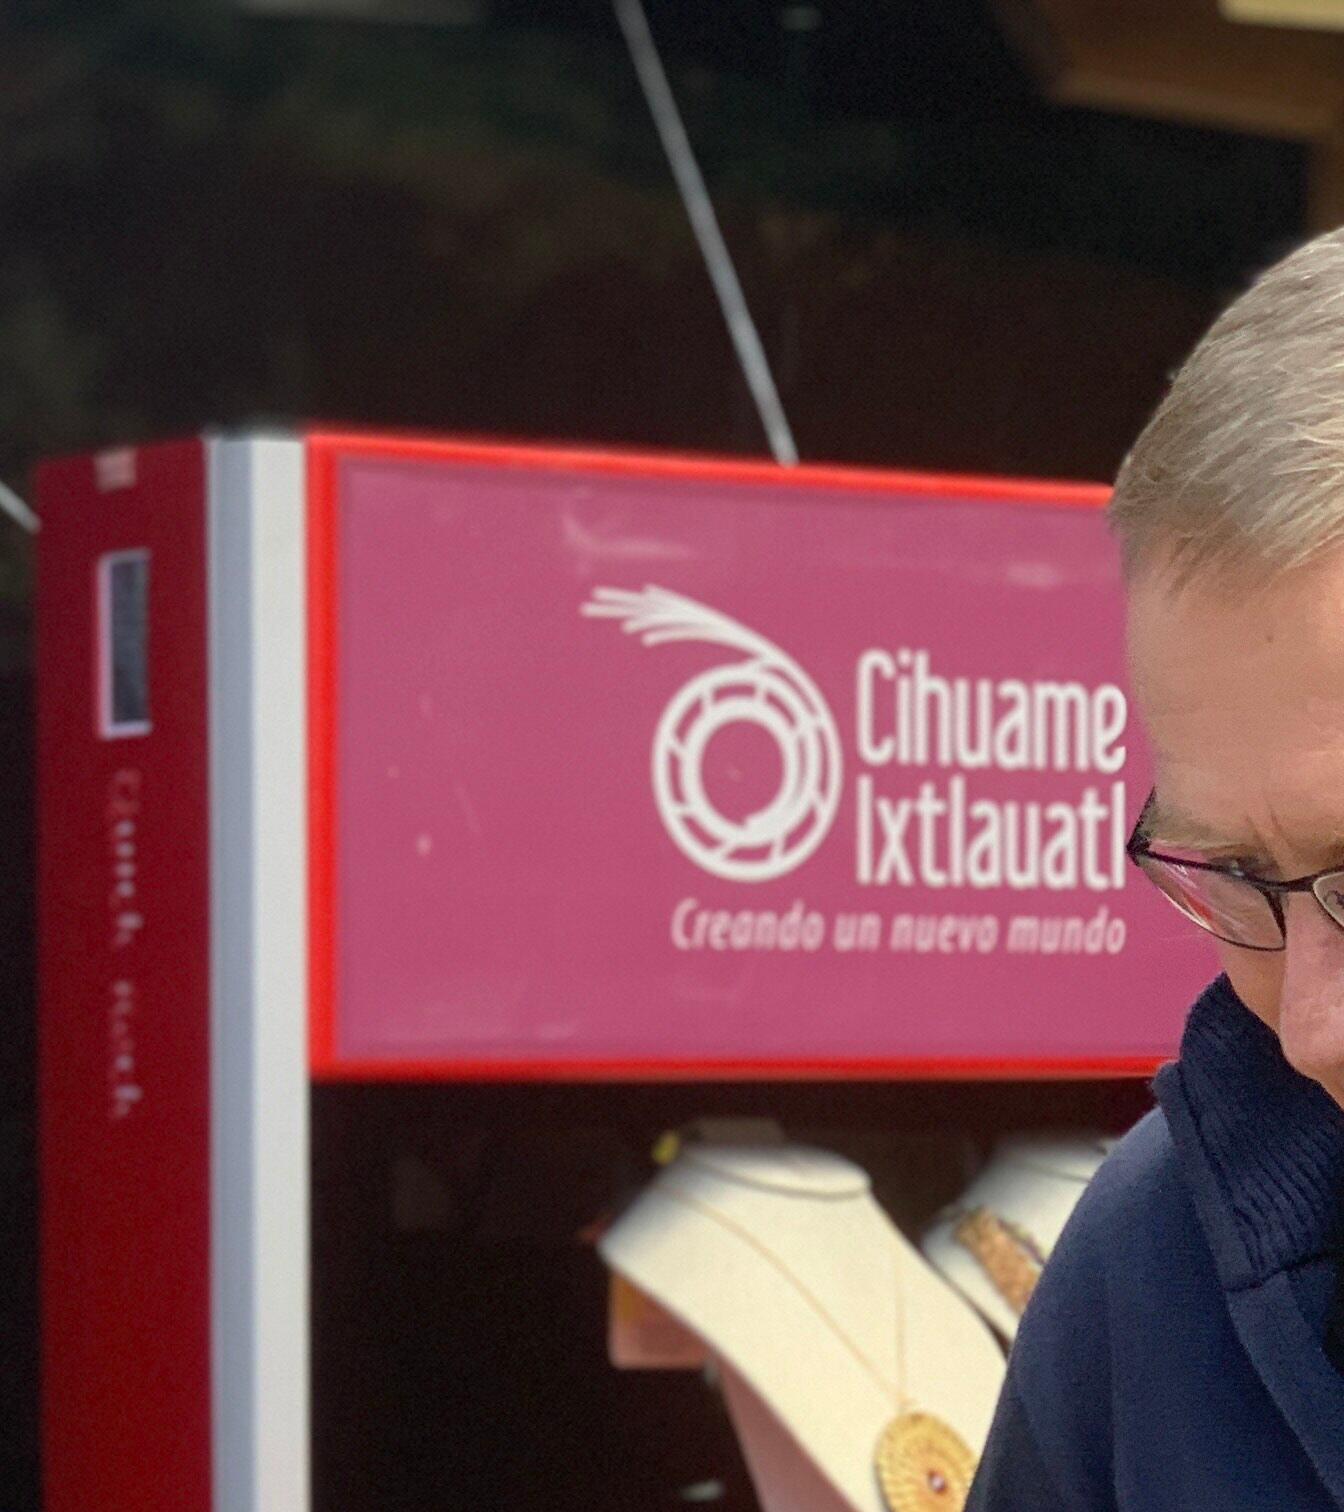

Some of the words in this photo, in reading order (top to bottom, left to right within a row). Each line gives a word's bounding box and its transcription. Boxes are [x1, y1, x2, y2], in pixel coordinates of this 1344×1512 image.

[857, 648, 1127, 774] Cihuame
[857, 773, 1126, 890] Ixtlauatl
[670, 897, 826, 951] Creando
[834, 911, 882, 952] un
[890, 913, 999, 953] nuevo
[1006, 906, 1127, 955] mundo
